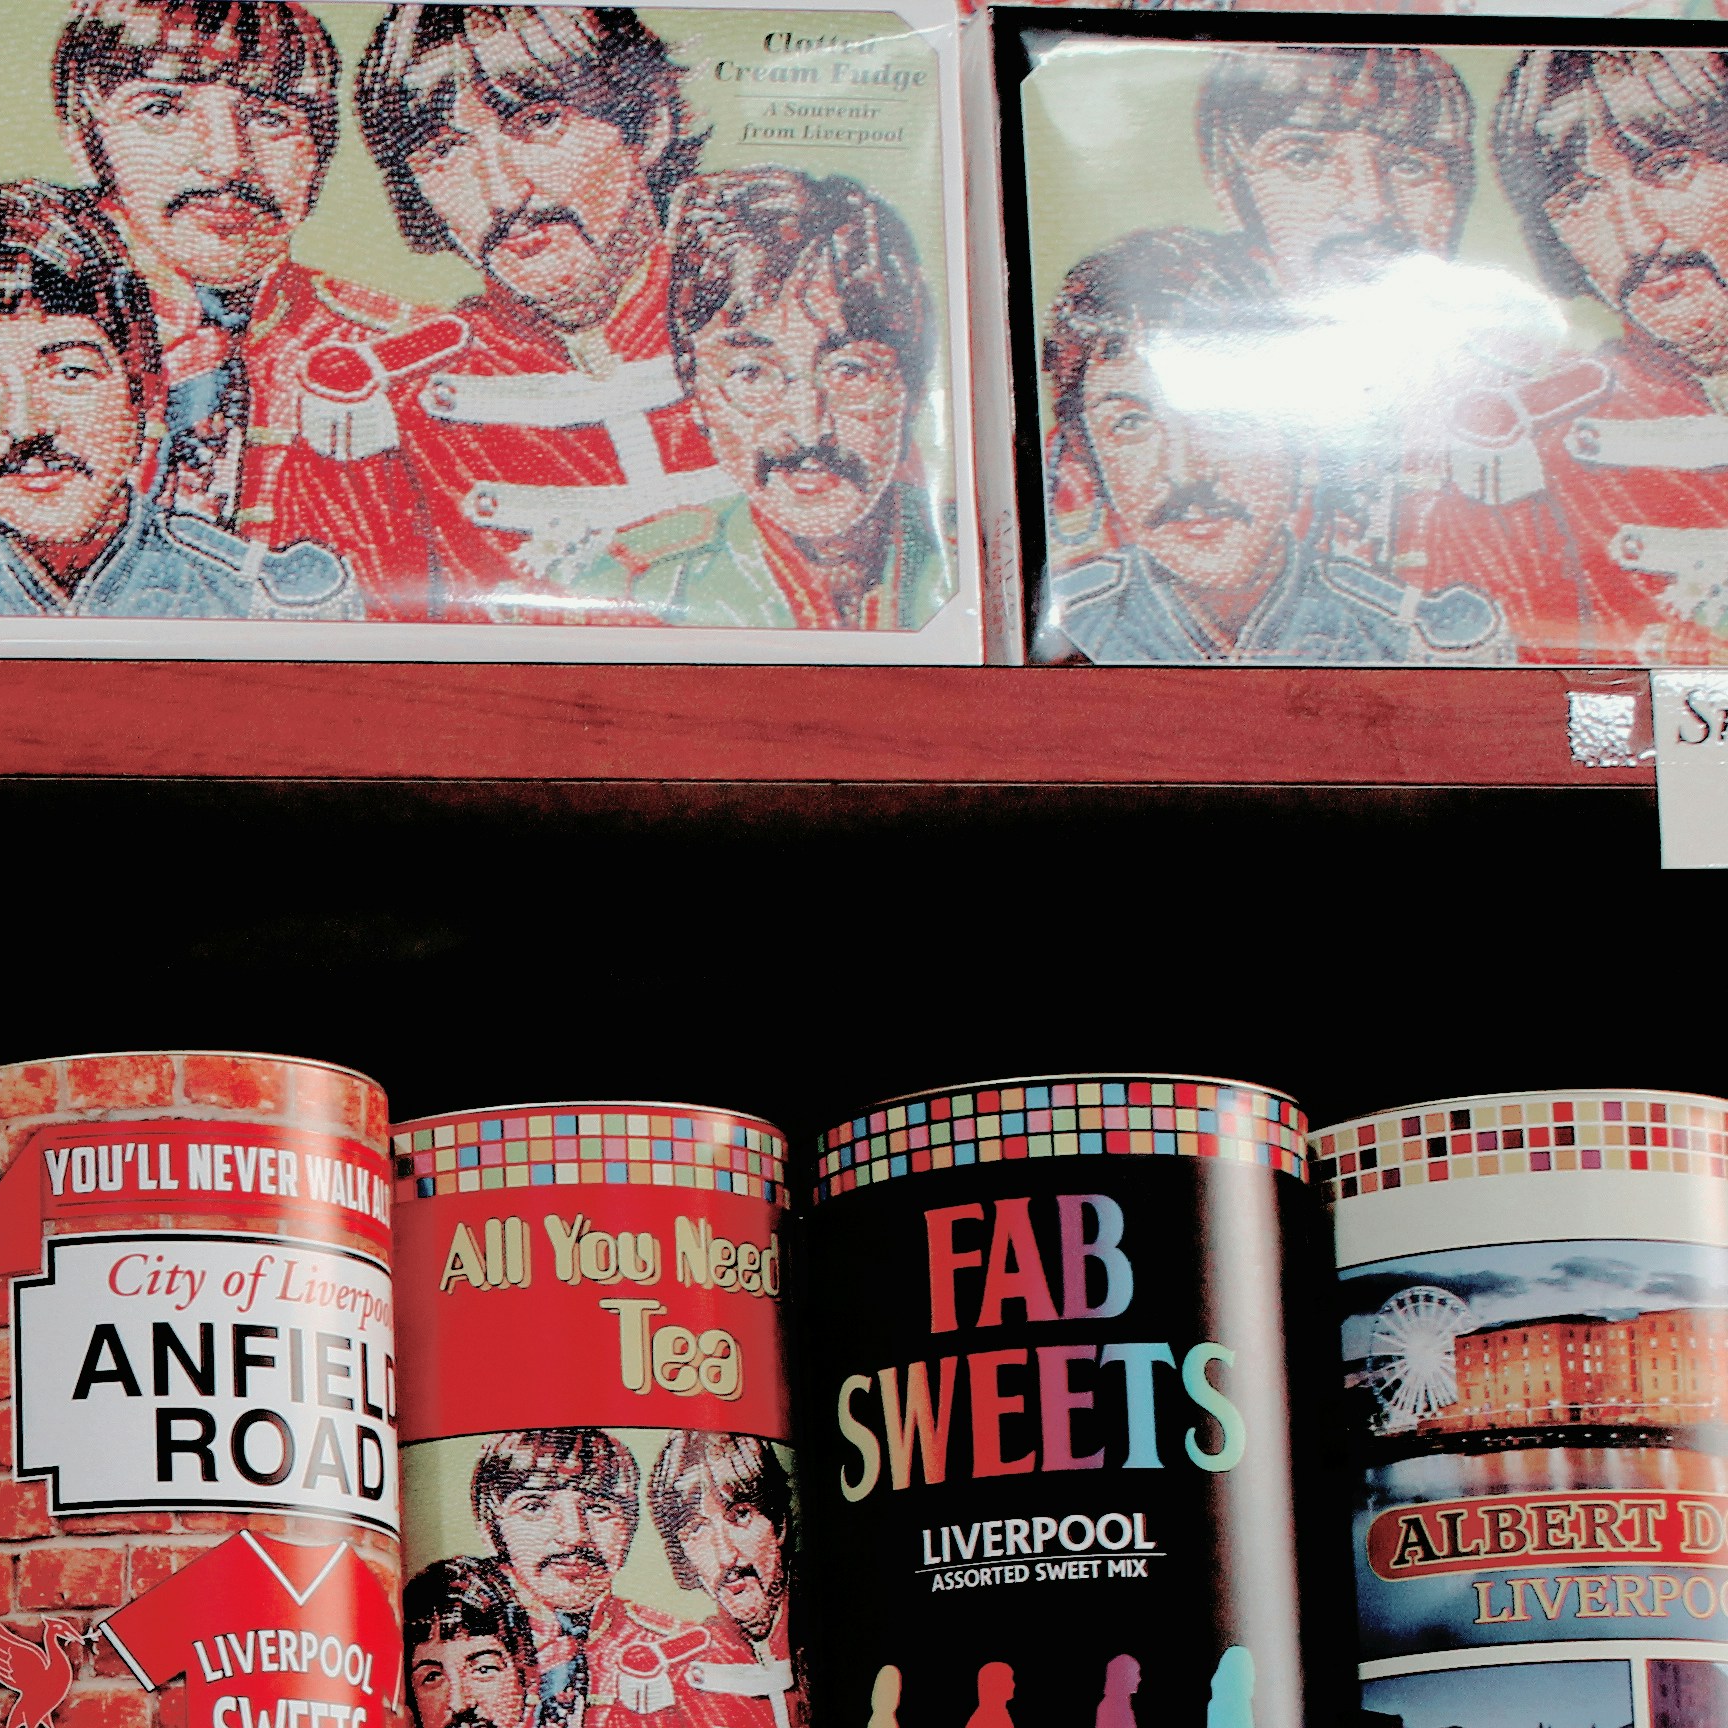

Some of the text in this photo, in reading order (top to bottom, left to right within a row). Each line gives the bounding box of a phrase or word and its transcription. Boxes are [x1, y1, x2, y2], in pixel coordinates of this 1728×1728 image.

[715, 60, 927, 91] Cream Fudge
[763, 102, 881, 119] A Souvenir
[188, 1143, 370, 1217] NEVER WALK
[108, 1252, 276, 1313] City of
[439, 1213, 779, 1297] All You Need
[924, 1194, 1134, 1333] FAB
[599, 1297, 742, 1400] Tea
[155, 1407, 384, 1501] ROAD
[838, 1342, 1245, 1503] SWEETS
[923, 1513, 1155, 1566] LIVERPOOL
[1390, 1500, 1668, 1569] ALBERT
[932, 1559, 1147, 1592] ASSORTED SWEET MIX
[192, 1630, 374, 1695] LIVERPOOL
